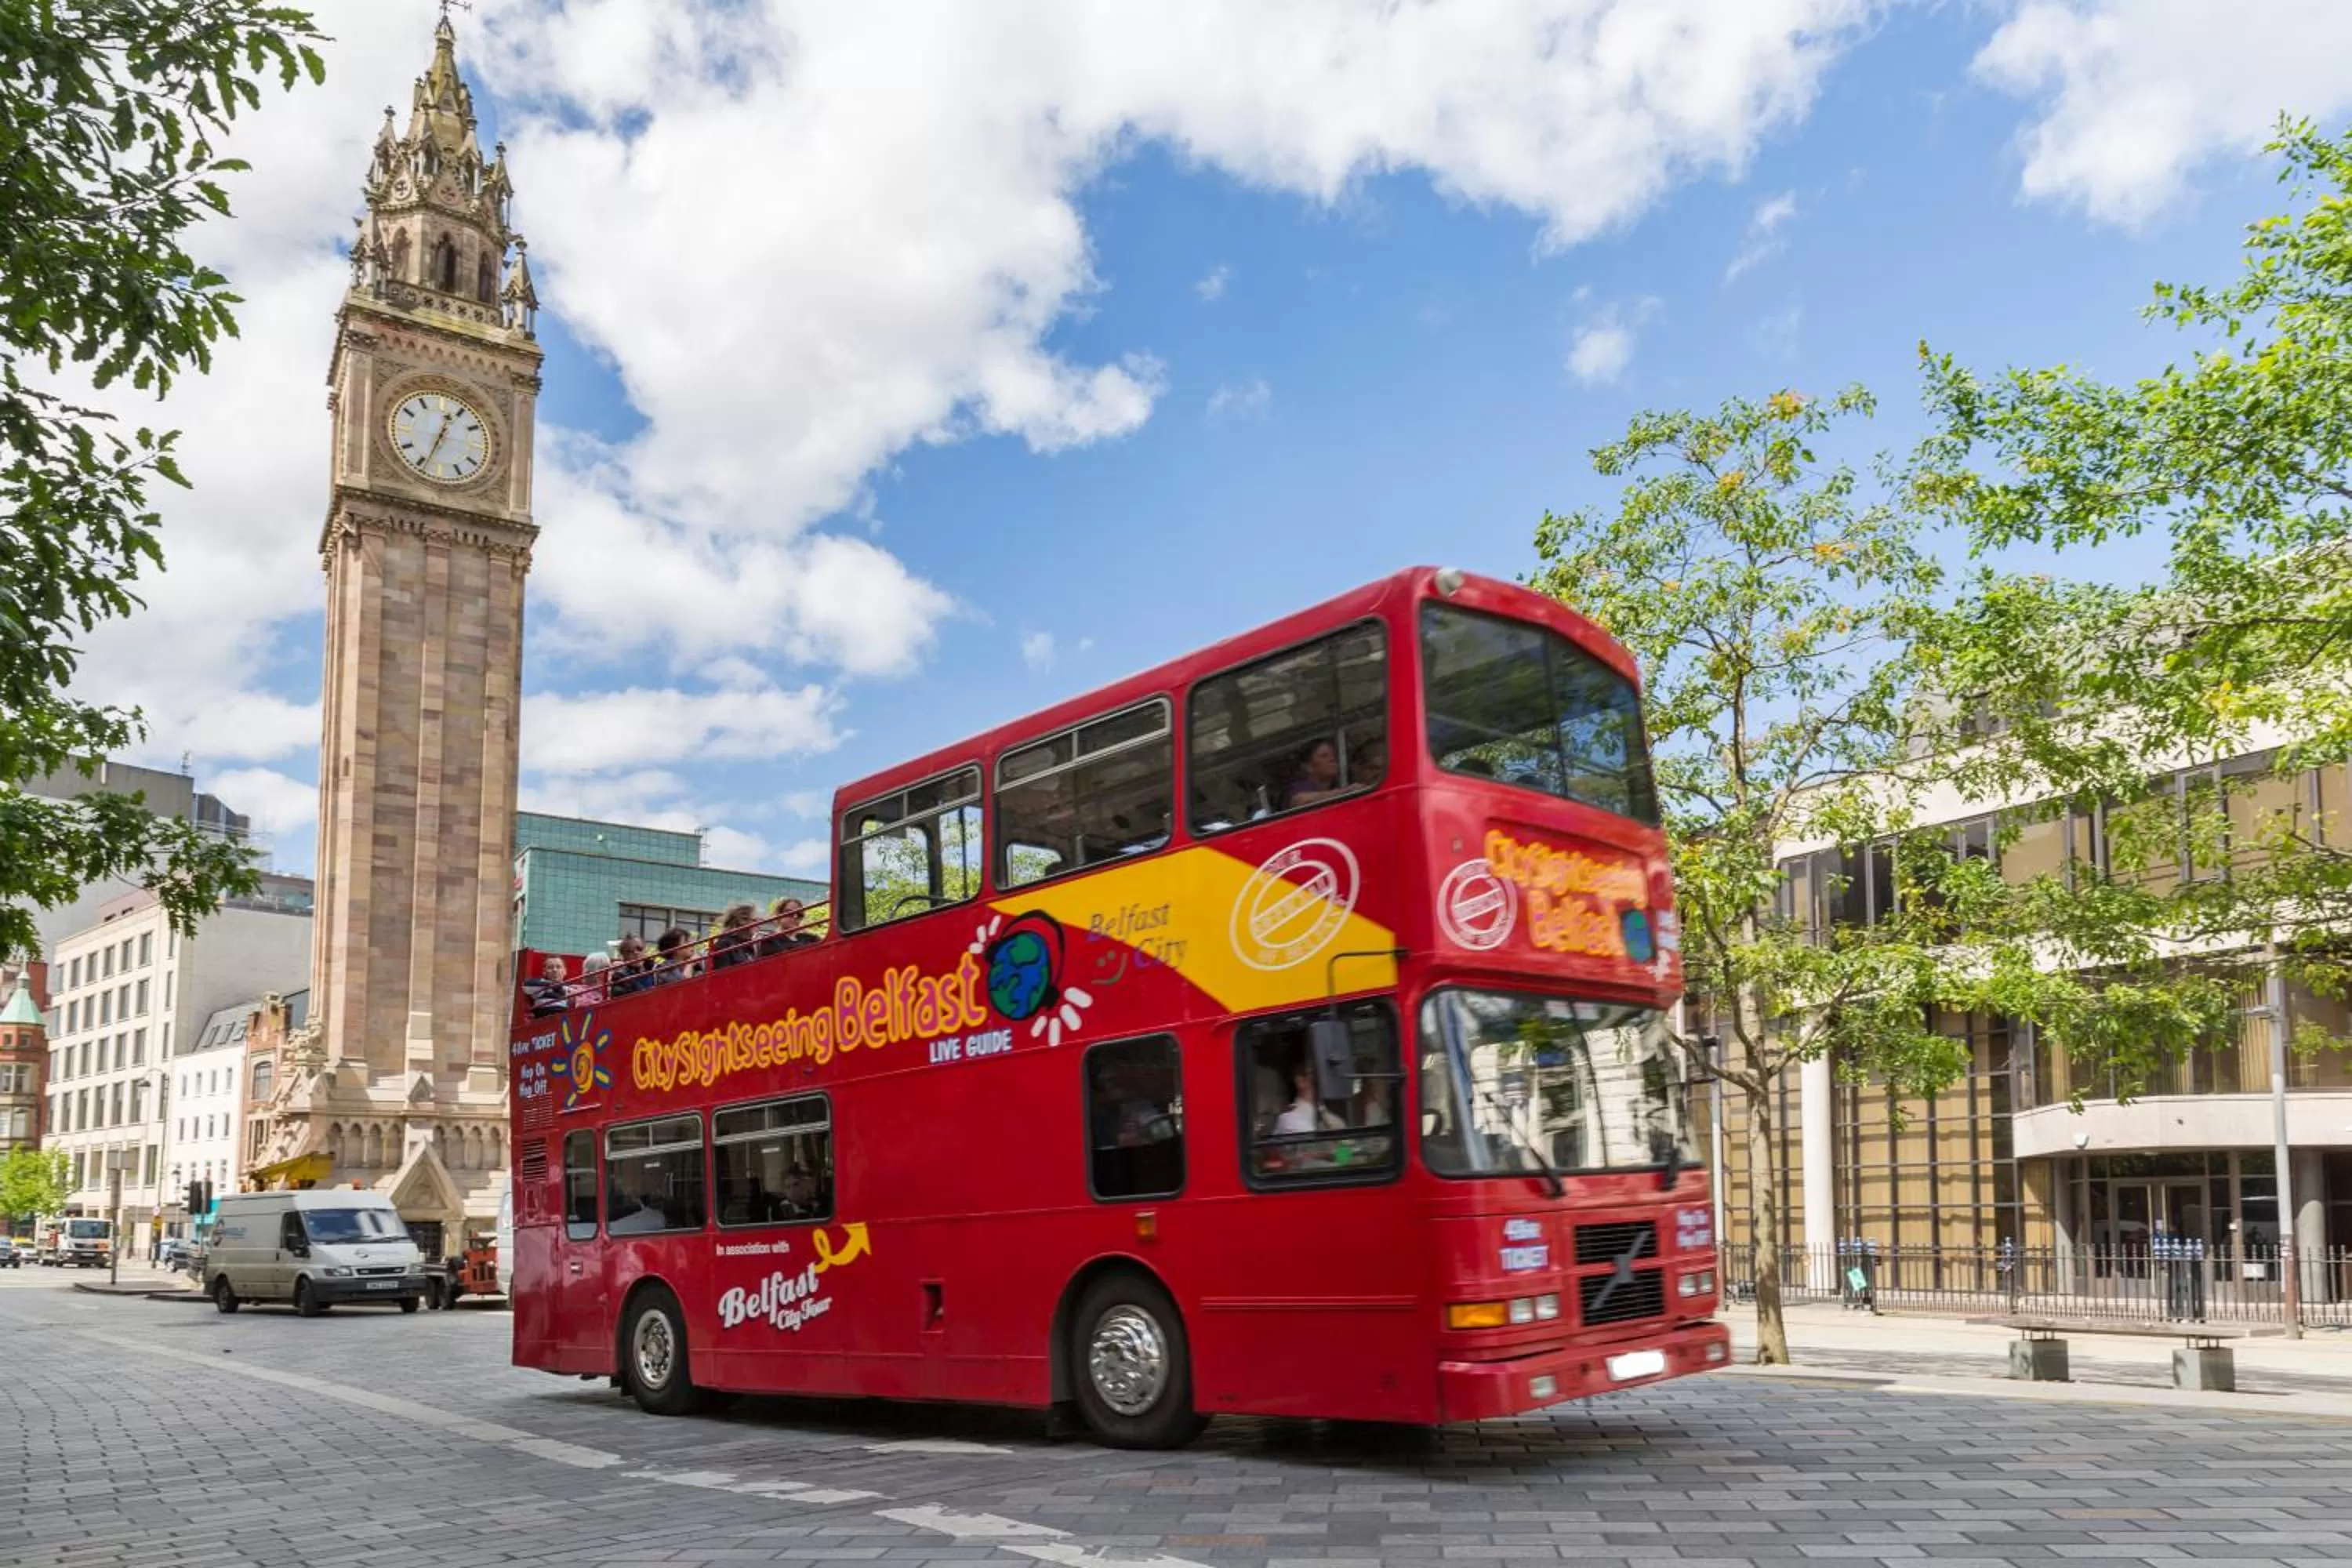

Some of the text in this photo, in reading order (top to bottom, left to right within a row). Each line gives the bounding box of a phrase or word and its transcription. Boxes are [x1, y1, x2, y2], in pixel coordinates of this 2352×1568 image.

[1087, 902, 1171, 942] Belfast
[1134, 936, 1188, 969] City
[833, 951, 988, 1052] Belfast
[929, 1028, 1012, 1063] LIVE GUIDE
[535, 1062, 546, 1077] On
[725, 1241, 771, 1255] association
[771, 1240, 790, 1254] with
[717, 1261, 819, 1330] Belfast
